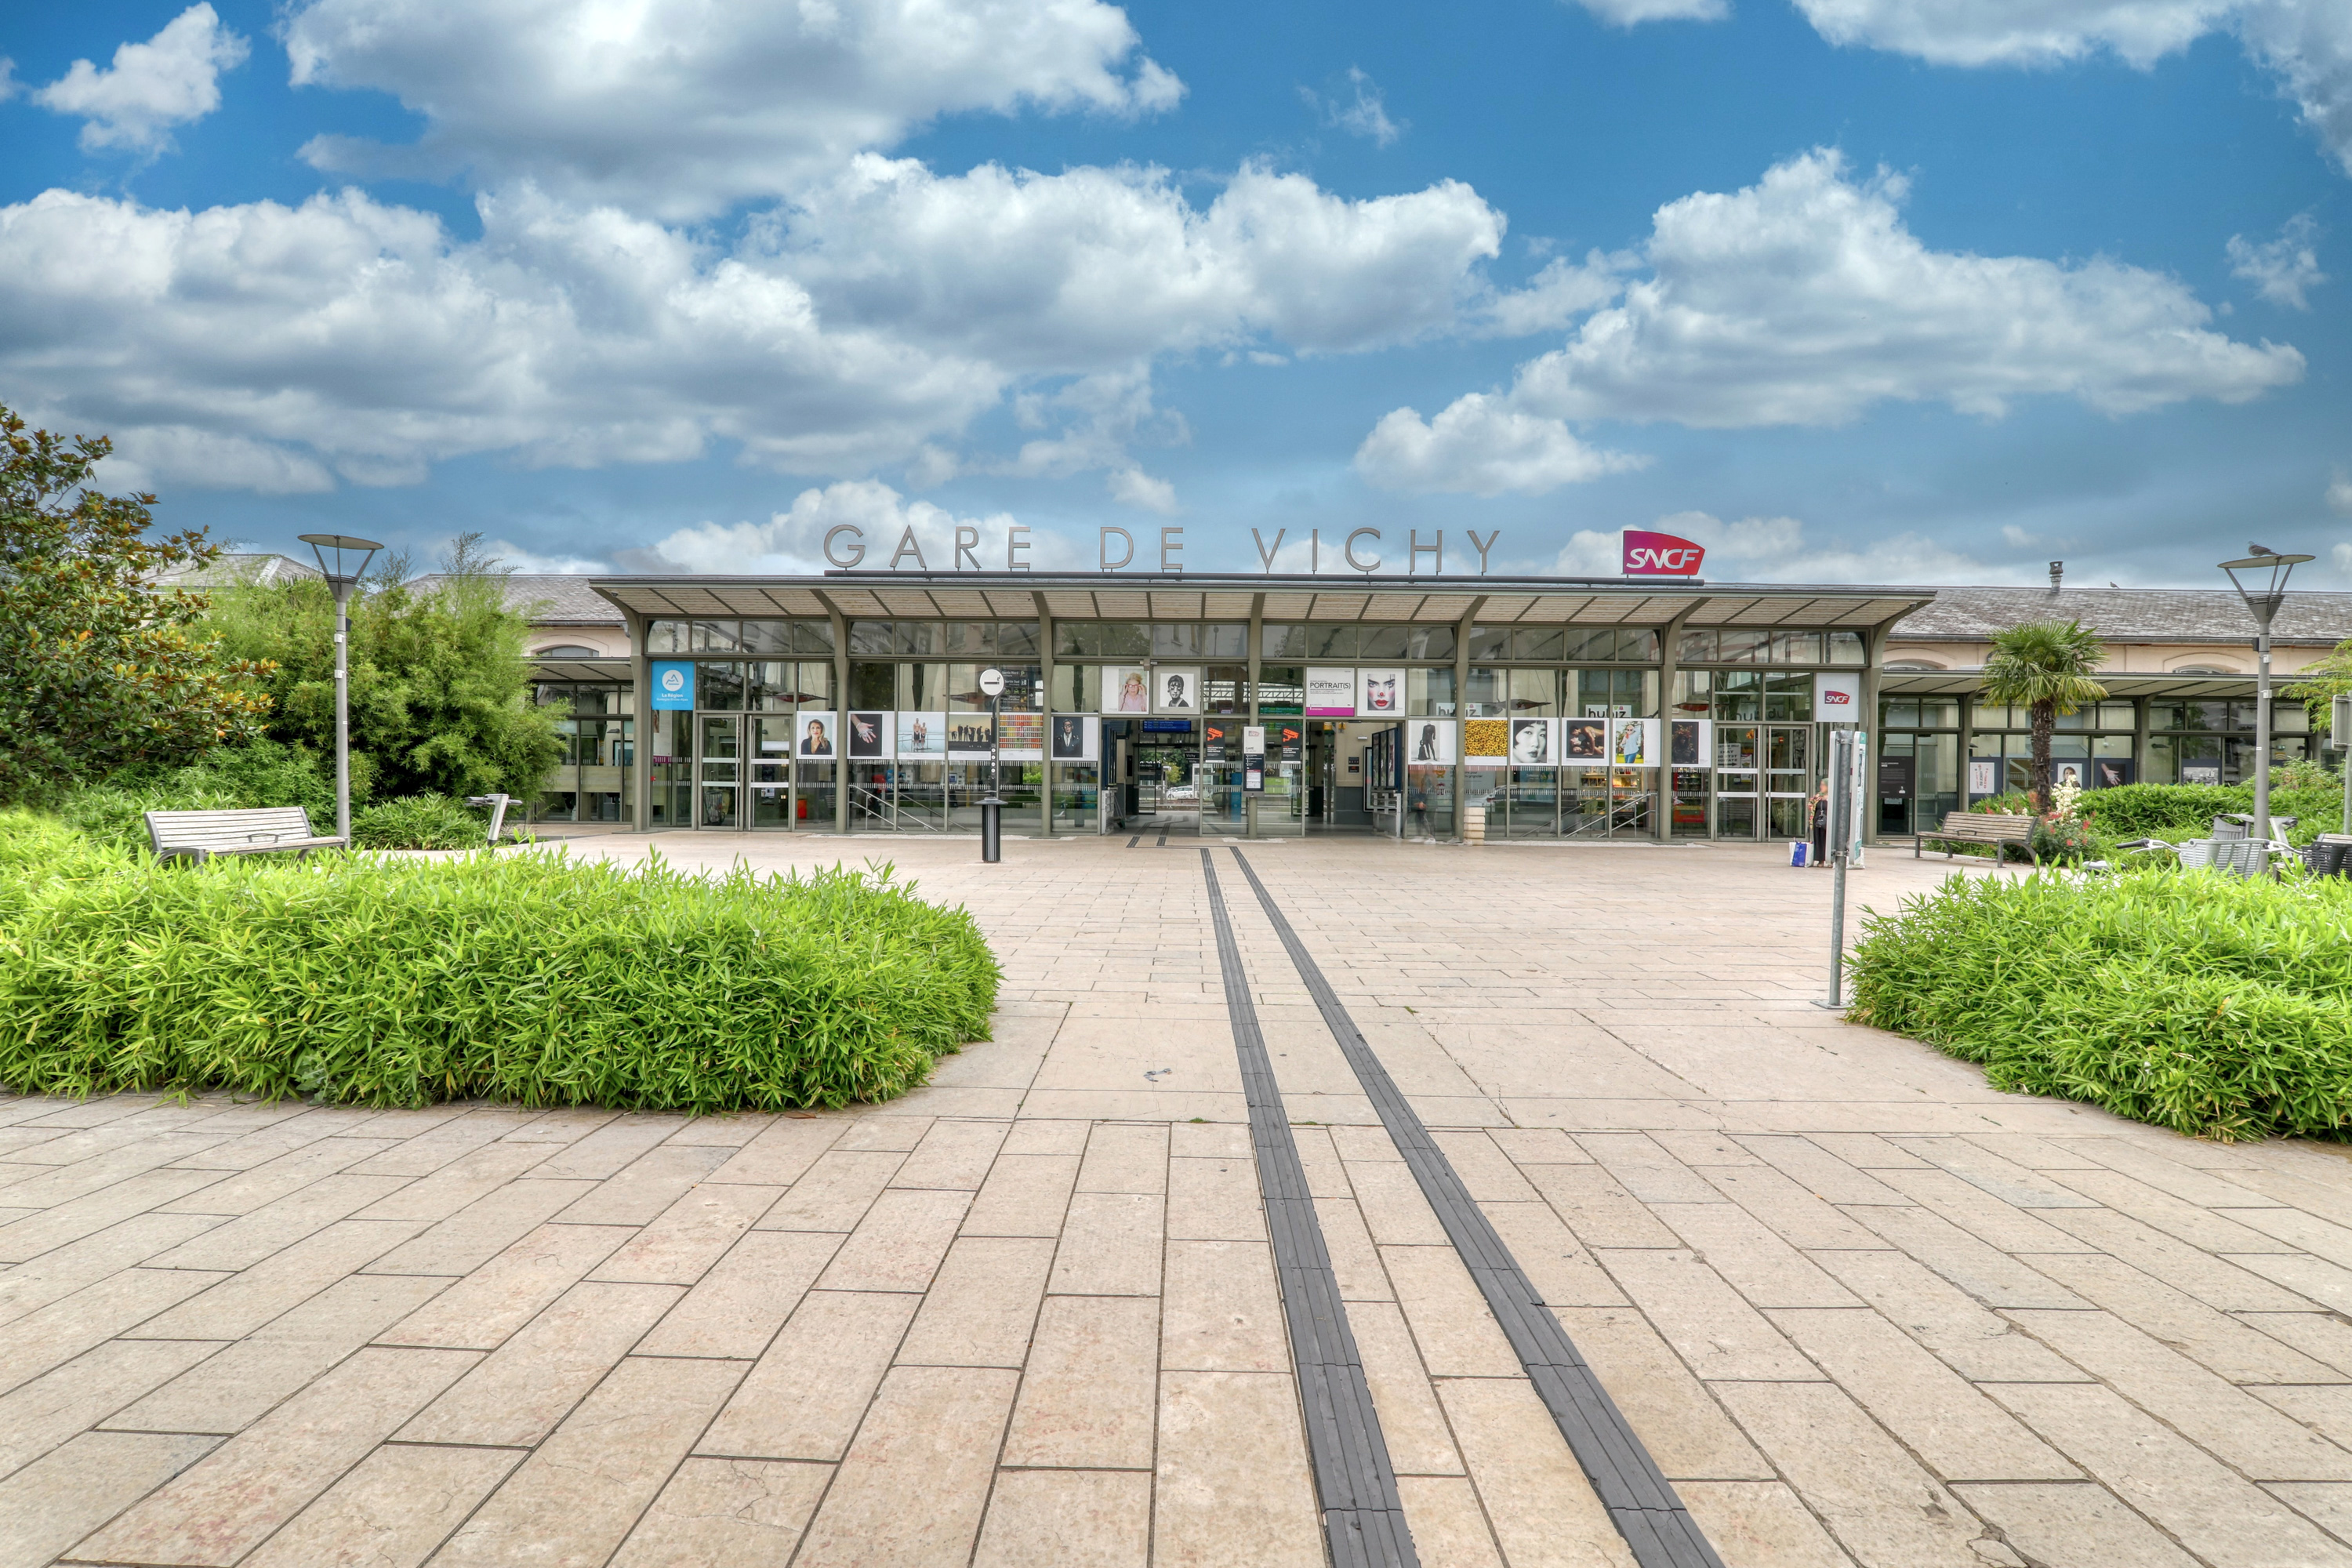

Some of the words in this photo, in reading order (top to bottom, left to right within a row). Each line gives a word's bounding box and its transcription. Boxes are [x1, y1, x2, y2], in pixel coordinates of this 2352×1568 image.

[824, 524, 1031, 568] GARE
[1100, 527, 1184, 570] DE
[1251, 528, 1500, 572] VICHY
[1626, 548, 1700, 569] SNCF
